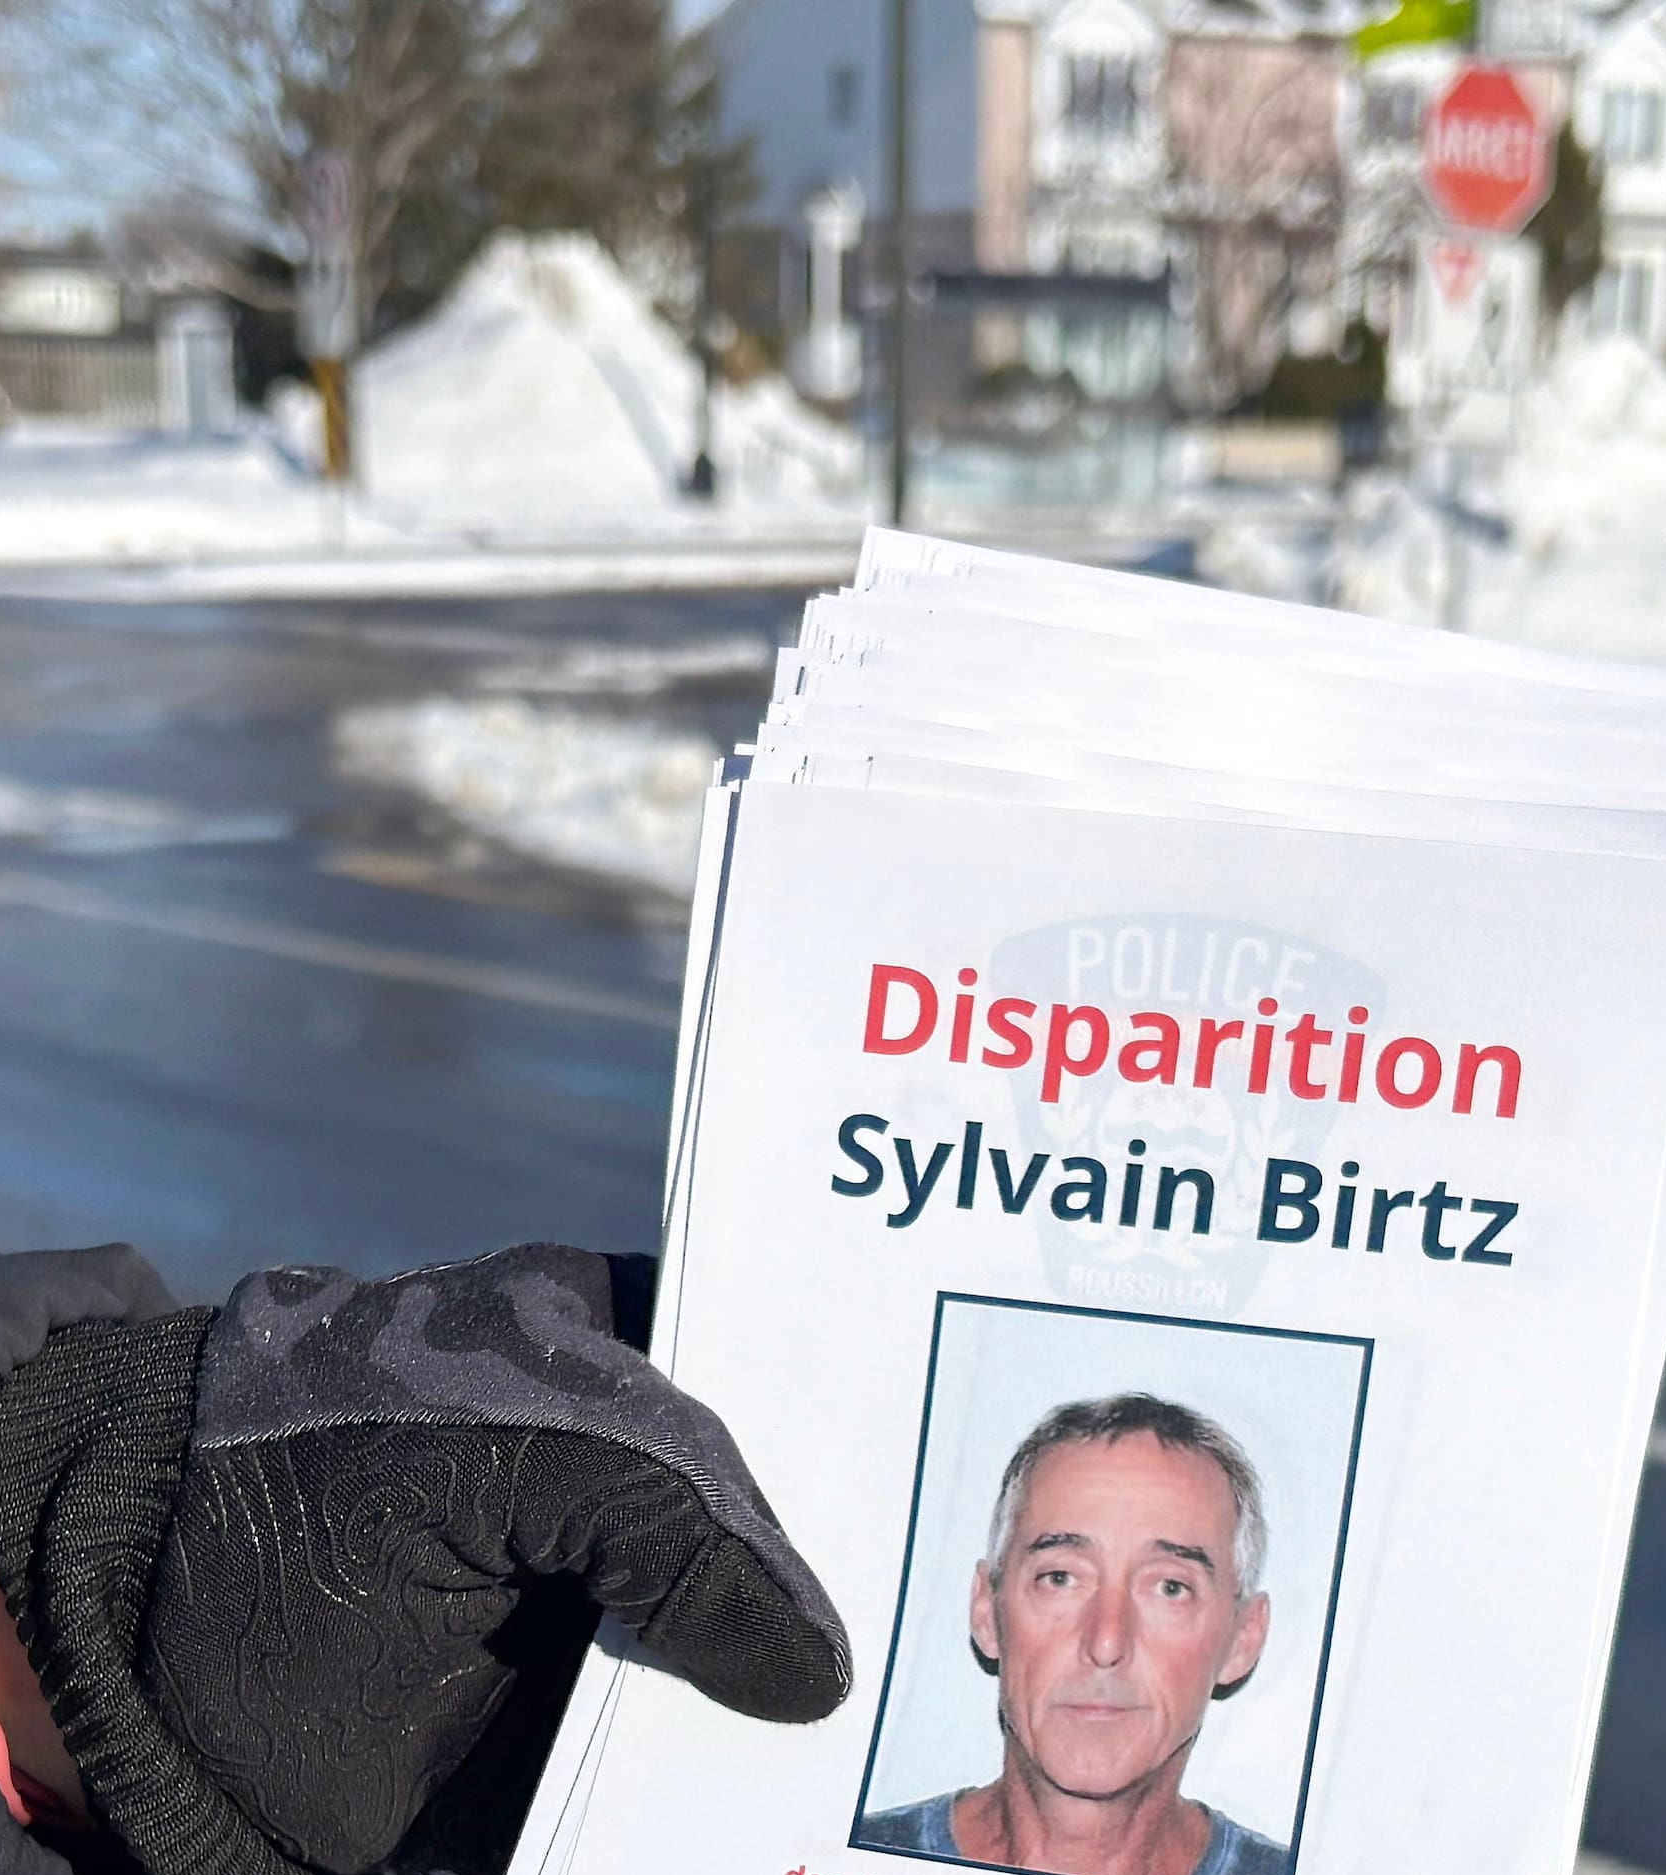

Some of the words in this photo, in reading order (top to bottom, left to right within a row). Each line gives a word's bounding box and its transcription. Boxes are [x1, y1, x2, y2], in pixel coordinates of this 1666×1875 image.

[862, 963, 1522, 1120] Disparition
[1066, 925, 1317, 1021] POLICE
[830, 1113, 1215, 1236] Sylvain
[1256, 1157, 1520, 1268] Birtz
